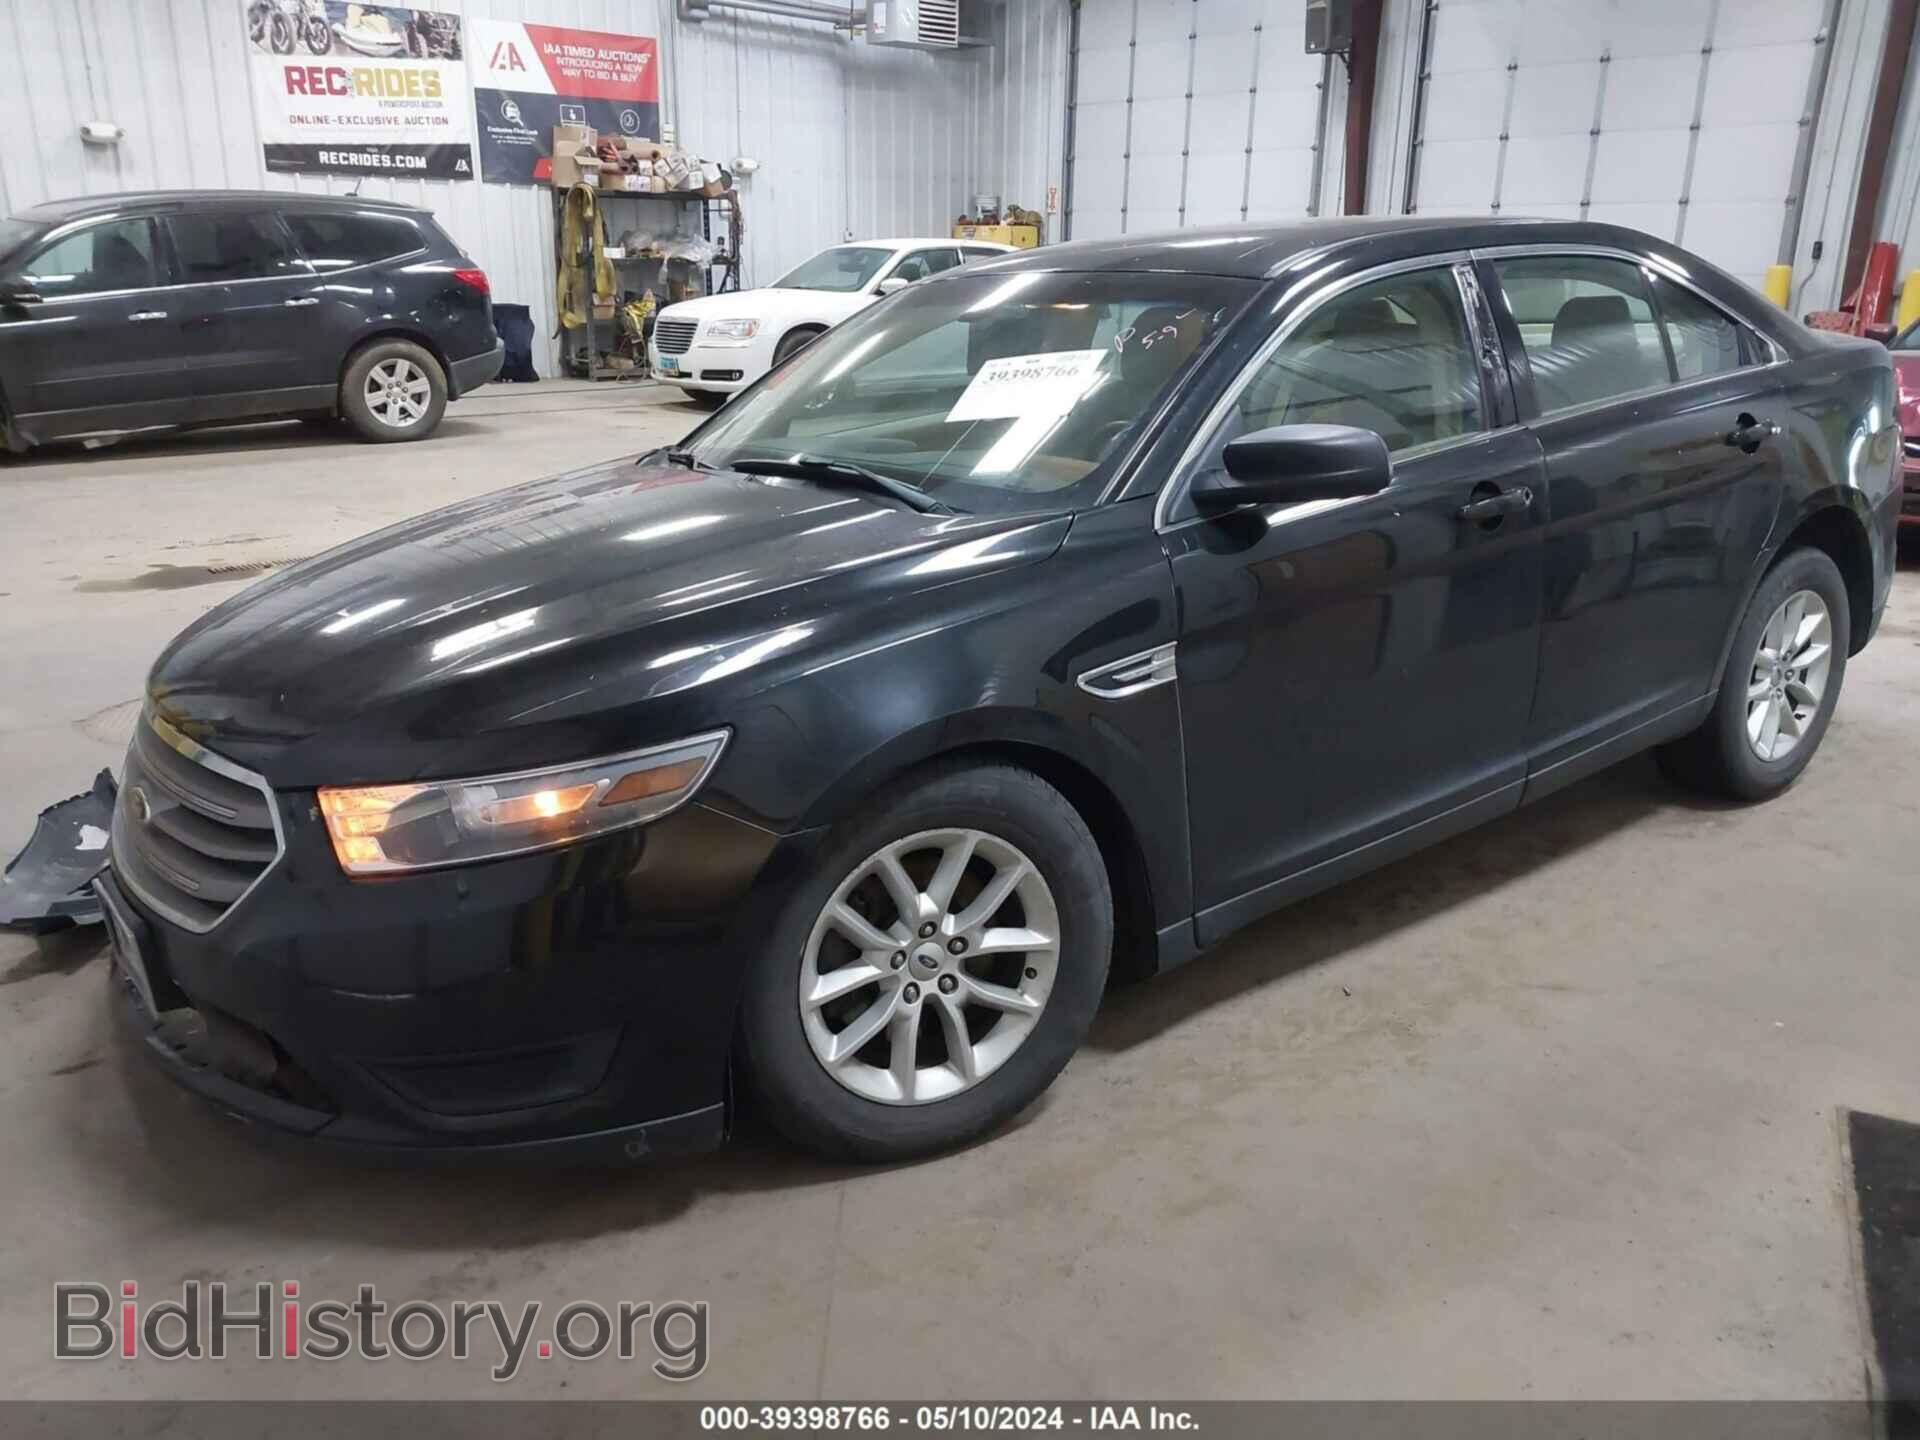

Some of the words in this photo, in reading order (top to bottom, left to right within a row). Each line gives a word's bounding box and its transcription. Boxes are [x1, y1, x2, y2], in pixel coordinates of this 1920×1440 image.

[544, 43, 561, 55] IAA
[563, 45, 596, 58] TIMED
[556, 57, 614, 70] INTRODUCING
[623, 64, 643, 73] NEW
[562, 68, 581, 78] WAY
[583, 68, 595, 79] TO
[597, 71, 610, 80] BID
[620, 73, 638, 82] BUY
[289, 114, 400, 126] ONLINE-EXCLUSIVE
[404, 116, 449, 126] AUCTION
[319, 151, 427, 169] RECRIDES.COM
